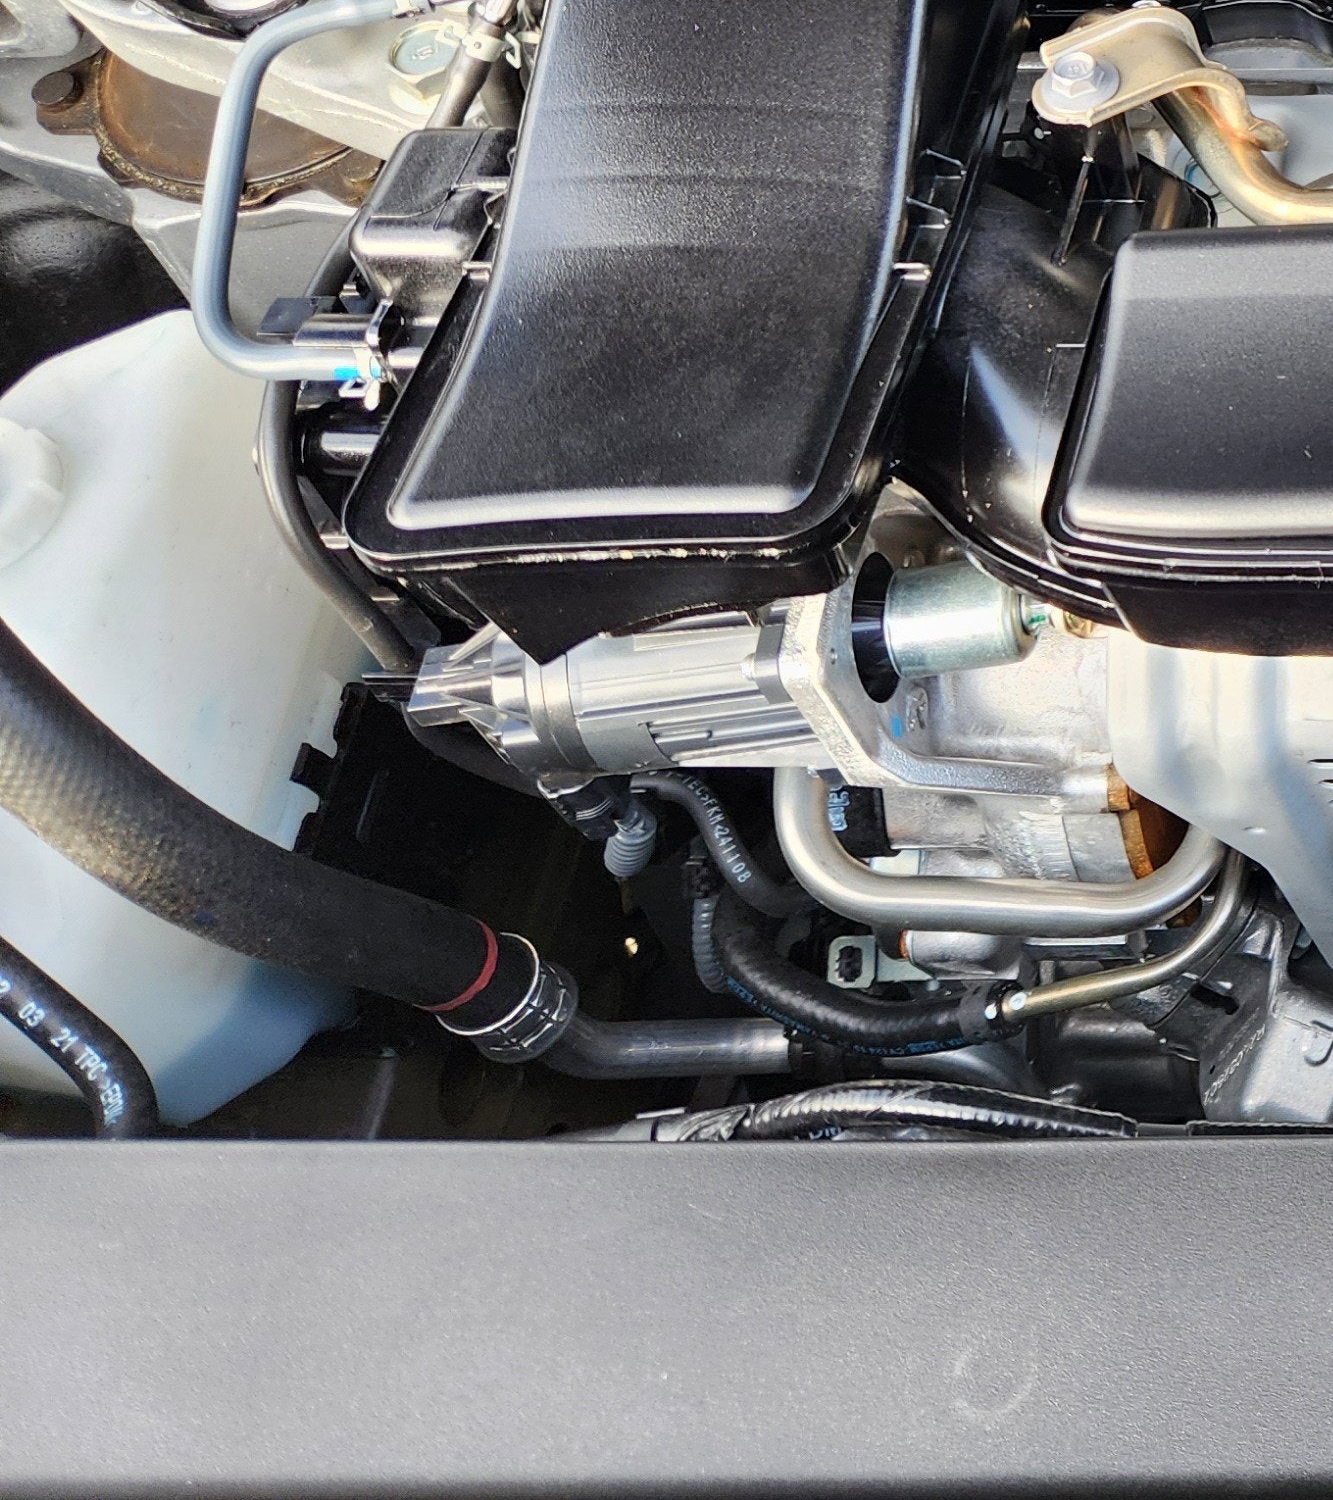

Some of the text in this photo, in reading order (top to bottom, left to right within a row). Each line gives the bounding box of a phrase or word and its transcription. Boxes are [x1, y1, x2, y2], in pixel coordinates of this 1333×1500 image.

[18, 1000, 46, 1028] 03
[50, 1026, 79, 1054] 21
[74, 1044, 108, 1082] TPC
